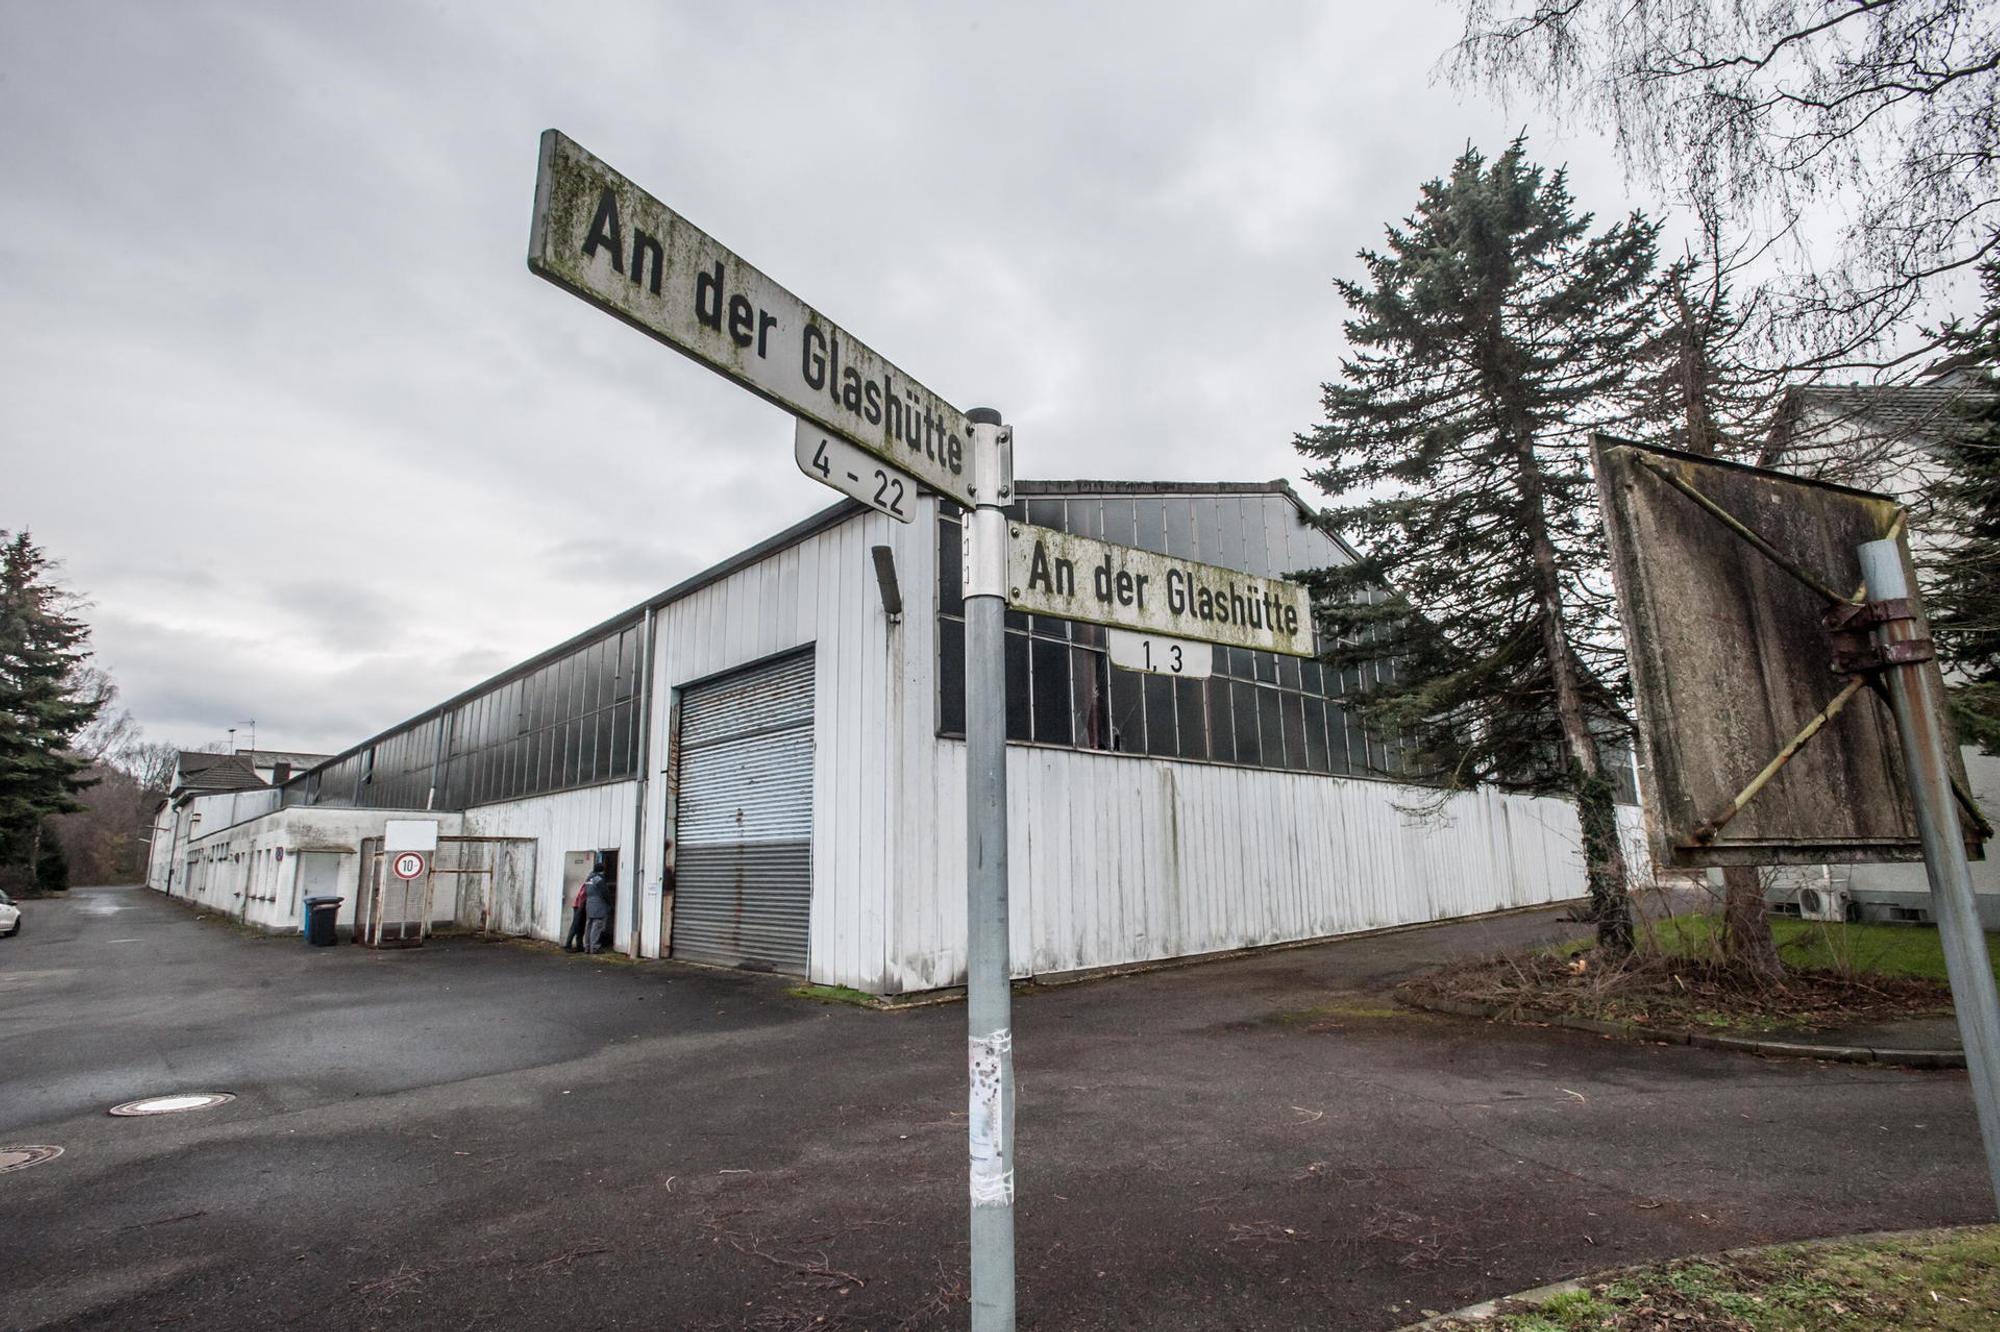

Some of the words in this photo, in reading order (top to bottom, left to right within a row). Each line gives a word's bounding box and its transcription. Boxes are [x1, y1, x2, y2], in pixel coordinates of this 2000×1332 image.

[581, 188, 664, 296] An
[695, 261, 778, 359] der
[801, 323, 963, 476] Glashütte
[812, 439, 831, 478] 4
[873, 469, 905, 516] 22
[1029, 540, 1075, 597] An
[1094, 554, 1149, 609] der
[1167, 568, 1299, 636] Glashütte
[1170, 645, 1183, 673] 3
[403, 859, 414, 872] 10
